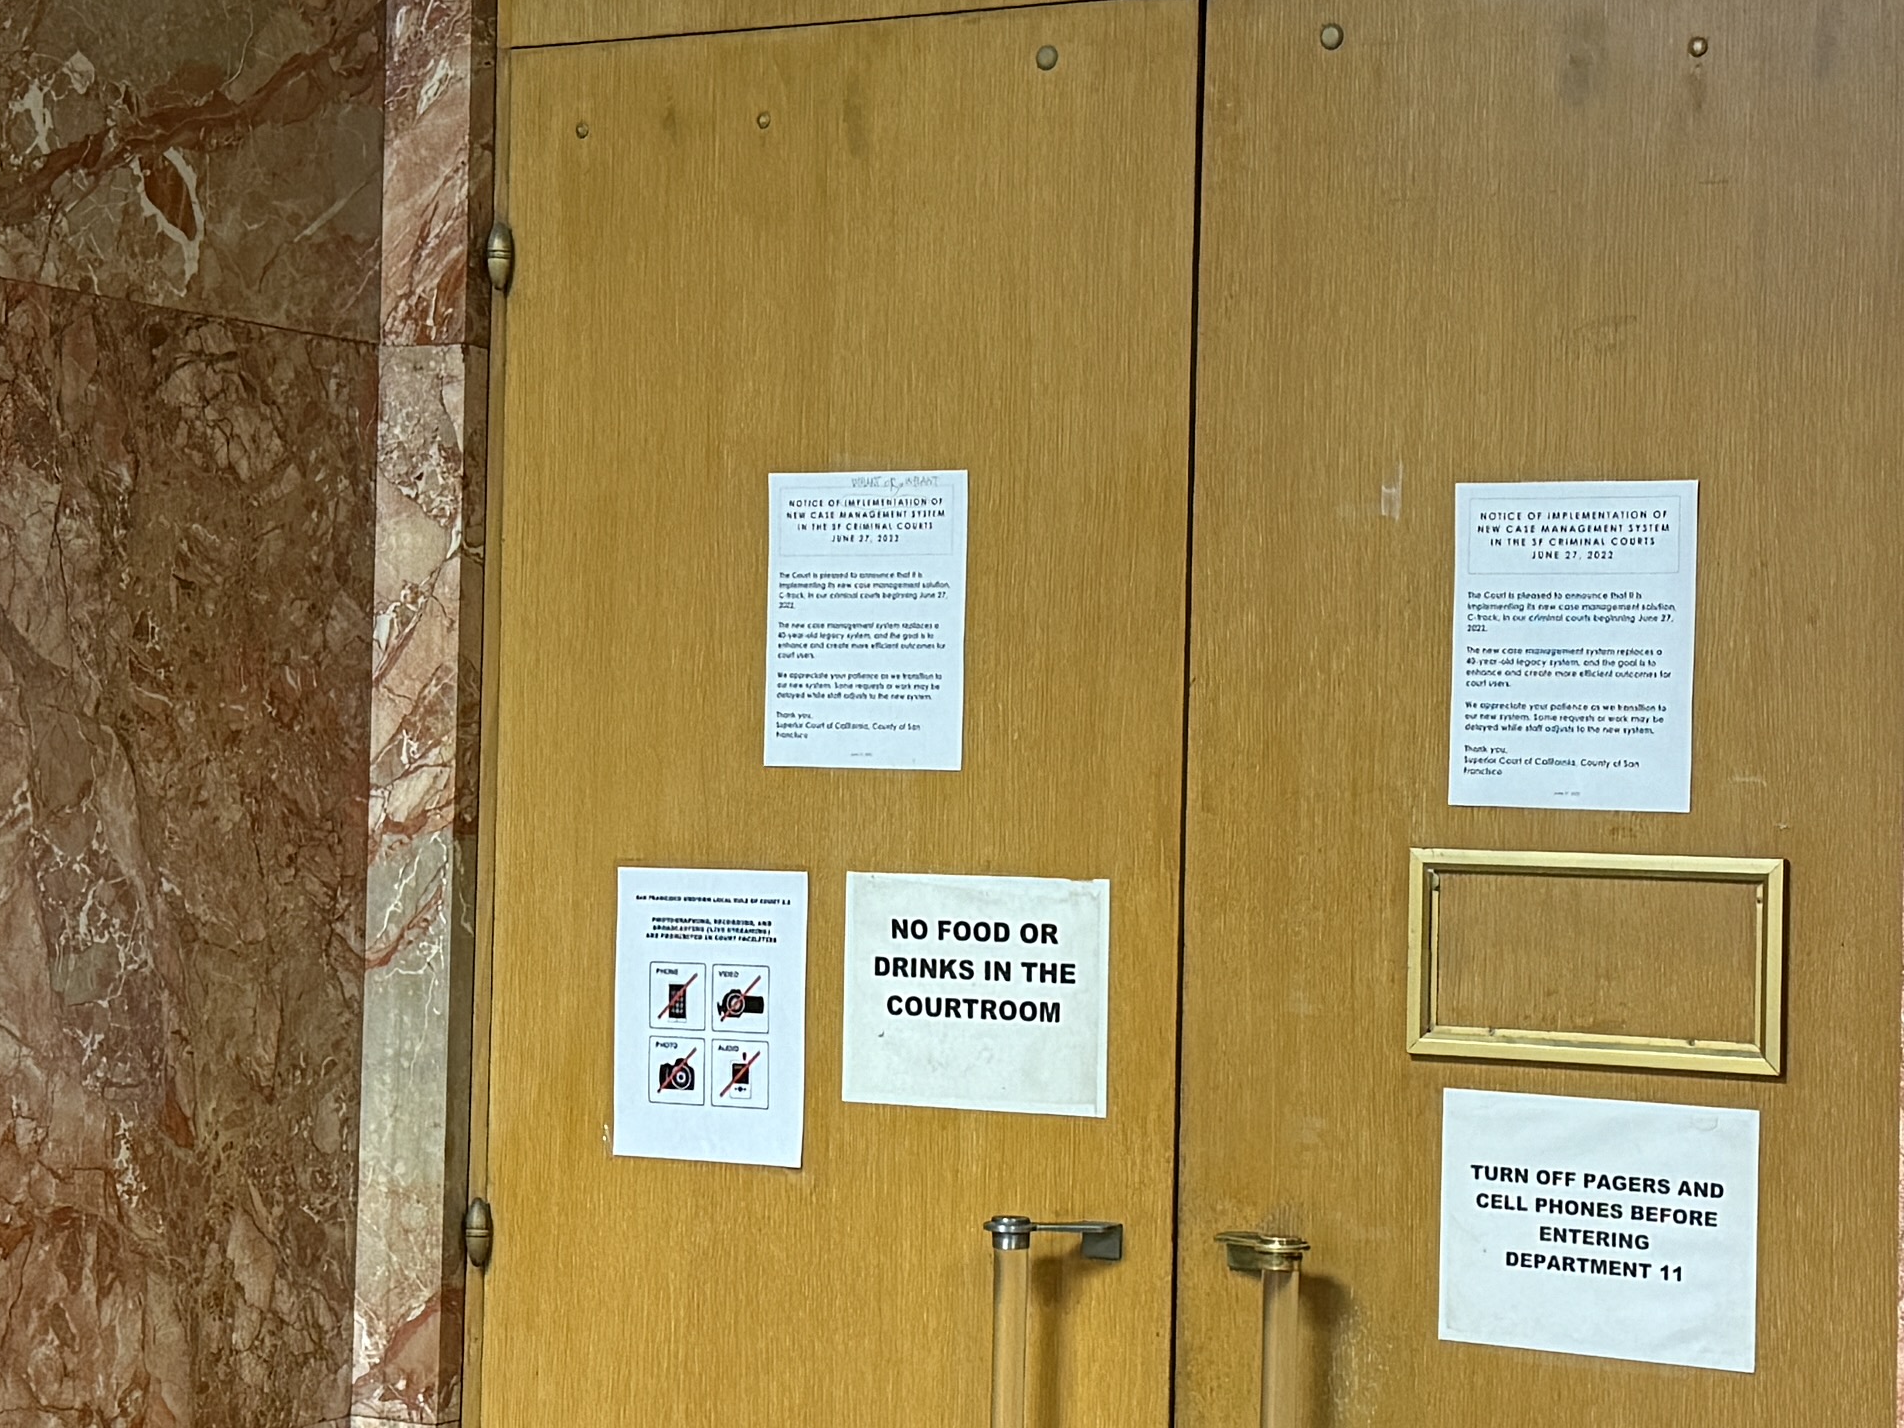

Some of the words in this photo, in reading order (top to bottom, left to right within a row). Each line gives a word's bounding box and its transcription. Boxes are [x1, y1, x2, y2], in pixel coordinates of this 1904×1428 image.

[1480, 512, 1521, 521] NOTICE
[1528, 512, 1542, 520] OF
[1547, 510, 1647, 520] IMPLEMENTATION
[1653, 510, 1667, 519] OF
[1477, 525, 1502, 534] NEW
[1506, 525, 1536, 534] CASE
[1541, 524, 1623, 533] MANAGEMENT
[1628, 524, 1670, 532] SYSTEM
[1490, 538, 1502, 546] IN
[1507, 538, 1526, 546] THE
[1549, 537, 1605, 546] CRIMINAL
[1611, 537, 1656, 545] COURTS
[1532, 551, 1560, 560] JUNE
[1587, 551, 1614, 560] 2022
[891, 919, 929, 941] NO
[937, 920, 1011, 944] FOOD
[1019, 923, 1059, 945] OR
[873, 956, 975, 981] DRINKS
[984, 960, 1011, 983] IN
[1020, 962, 1077, 985] THE
[886, 995, 1061, 1023] COURTROOM
[1470, 1164, 1529, 1184] TURN
[1536, 1168, 1577, 1188] OFF
[1583, 1172, 1671, 1196] PAGERS
[1677, 1179, 1725, 1200] AND
[1475, 1192, 1529, 1213] CELL
[1535, 1197, 1624, 1221] PHONES
[1630, 1204, 1718, 1228] BEFORE
[1539, 1225, 1650, 1251] ENTERING
[1505, 1250, 1651, 1280] DEPARTMENT
[1659, 1264, 1684, 1283] 11
